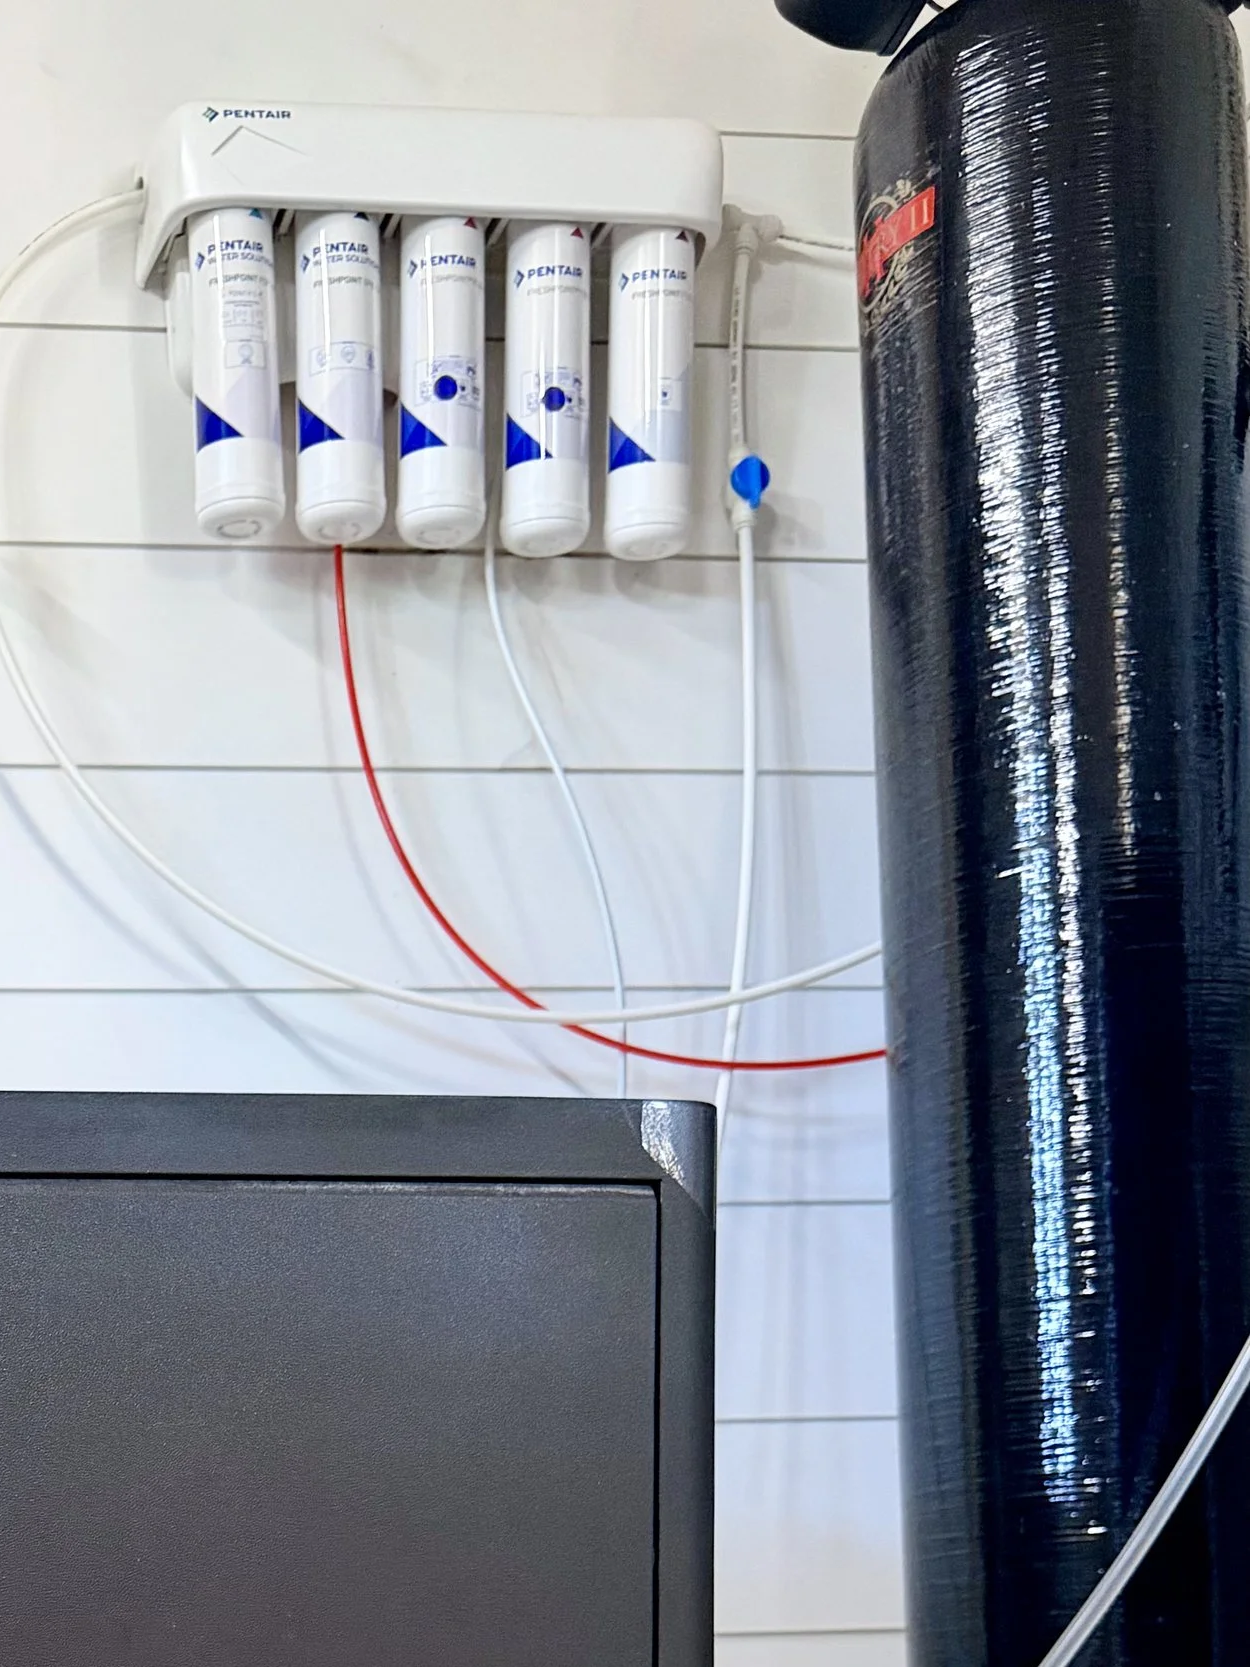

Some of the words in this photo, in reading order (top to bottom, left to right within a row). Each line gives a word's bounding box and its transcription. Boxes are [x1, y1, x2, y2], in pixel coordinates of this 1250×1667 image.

[222, 108, 292, 120] PENTAIR
[527, 265, 583, 280] PENTAIR
[631, 268, 688, 283] PENTAIR
